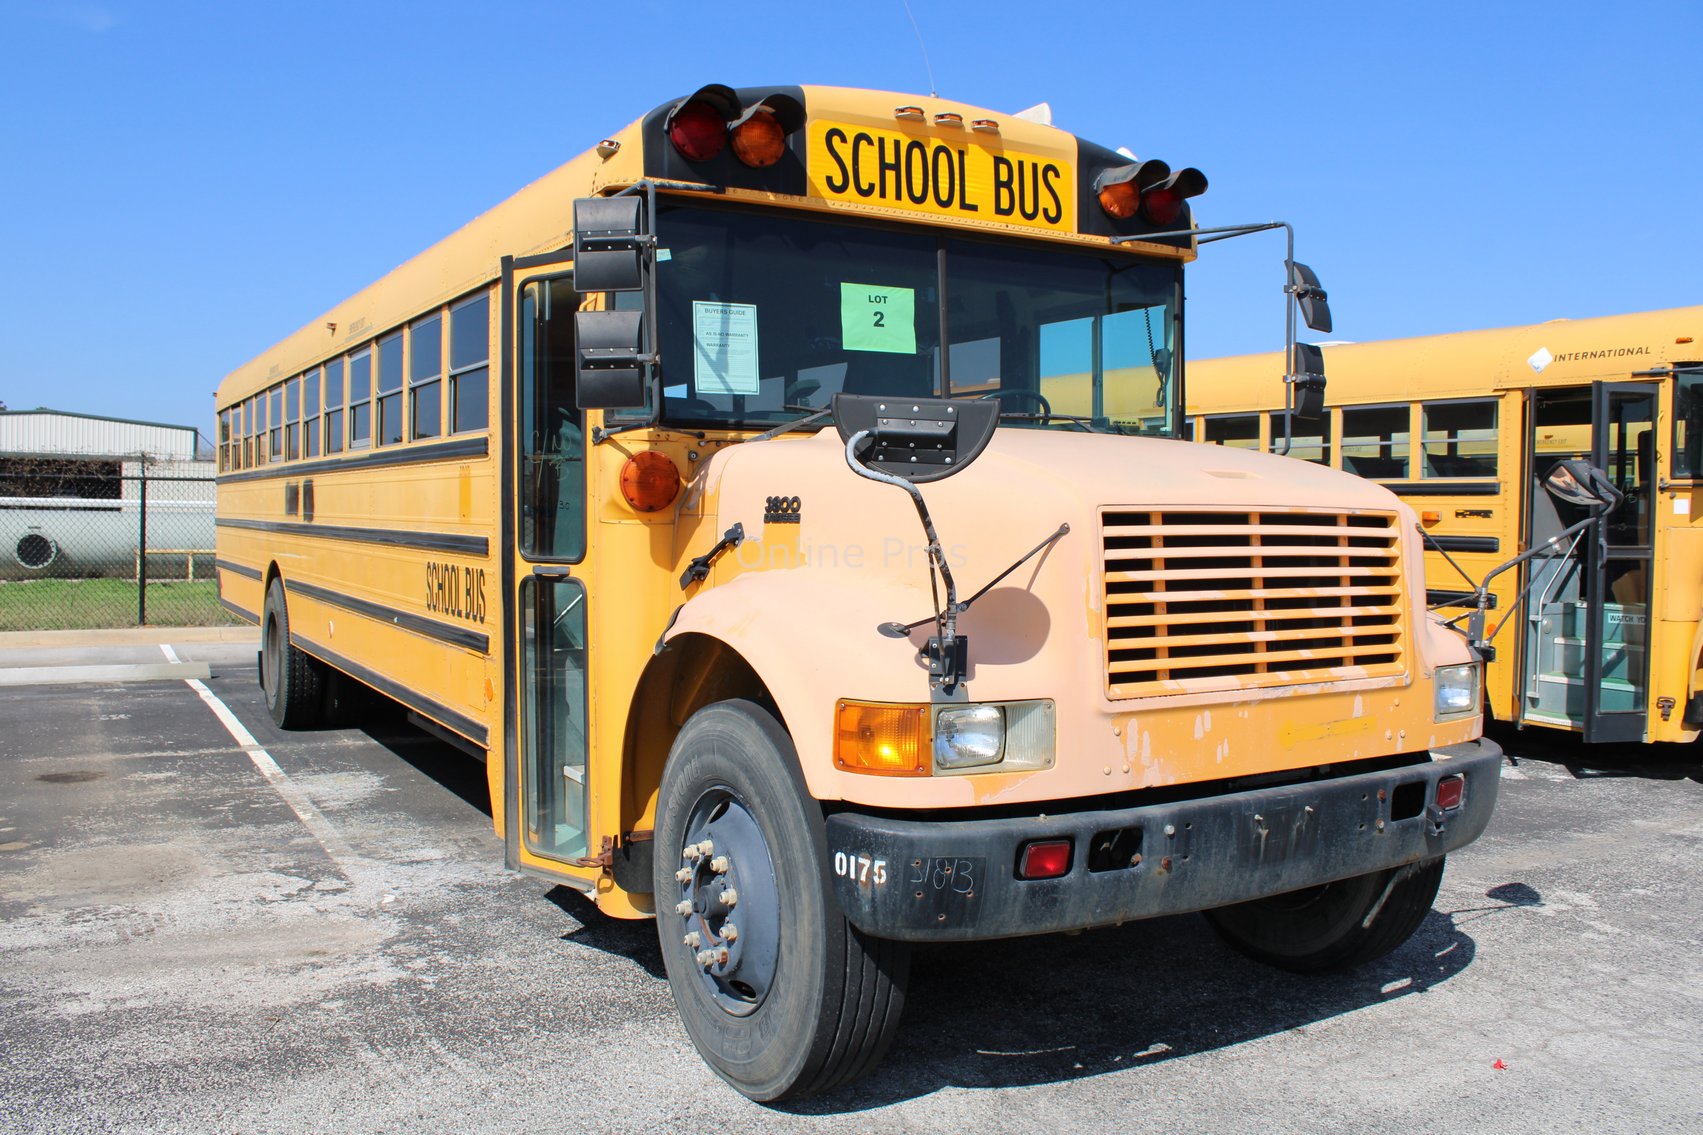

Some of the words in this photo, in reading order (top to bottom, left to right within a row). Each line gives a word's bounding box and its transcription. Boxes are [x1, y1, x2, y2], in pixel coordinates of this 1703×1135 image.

[825, 128, 978, 212] SCHOOL
[993, 155, 1063, 225] BUS
[868, 295, 888, 304] LOT
[873, 311, 885, 328] 2
[1553, 346, 1651, 362] INTERNATIONAL
[426, 561, 462, 618] SCHOOL
[465, 567, 486, 624] BUS
[835, 851, 887, 884] 0175
